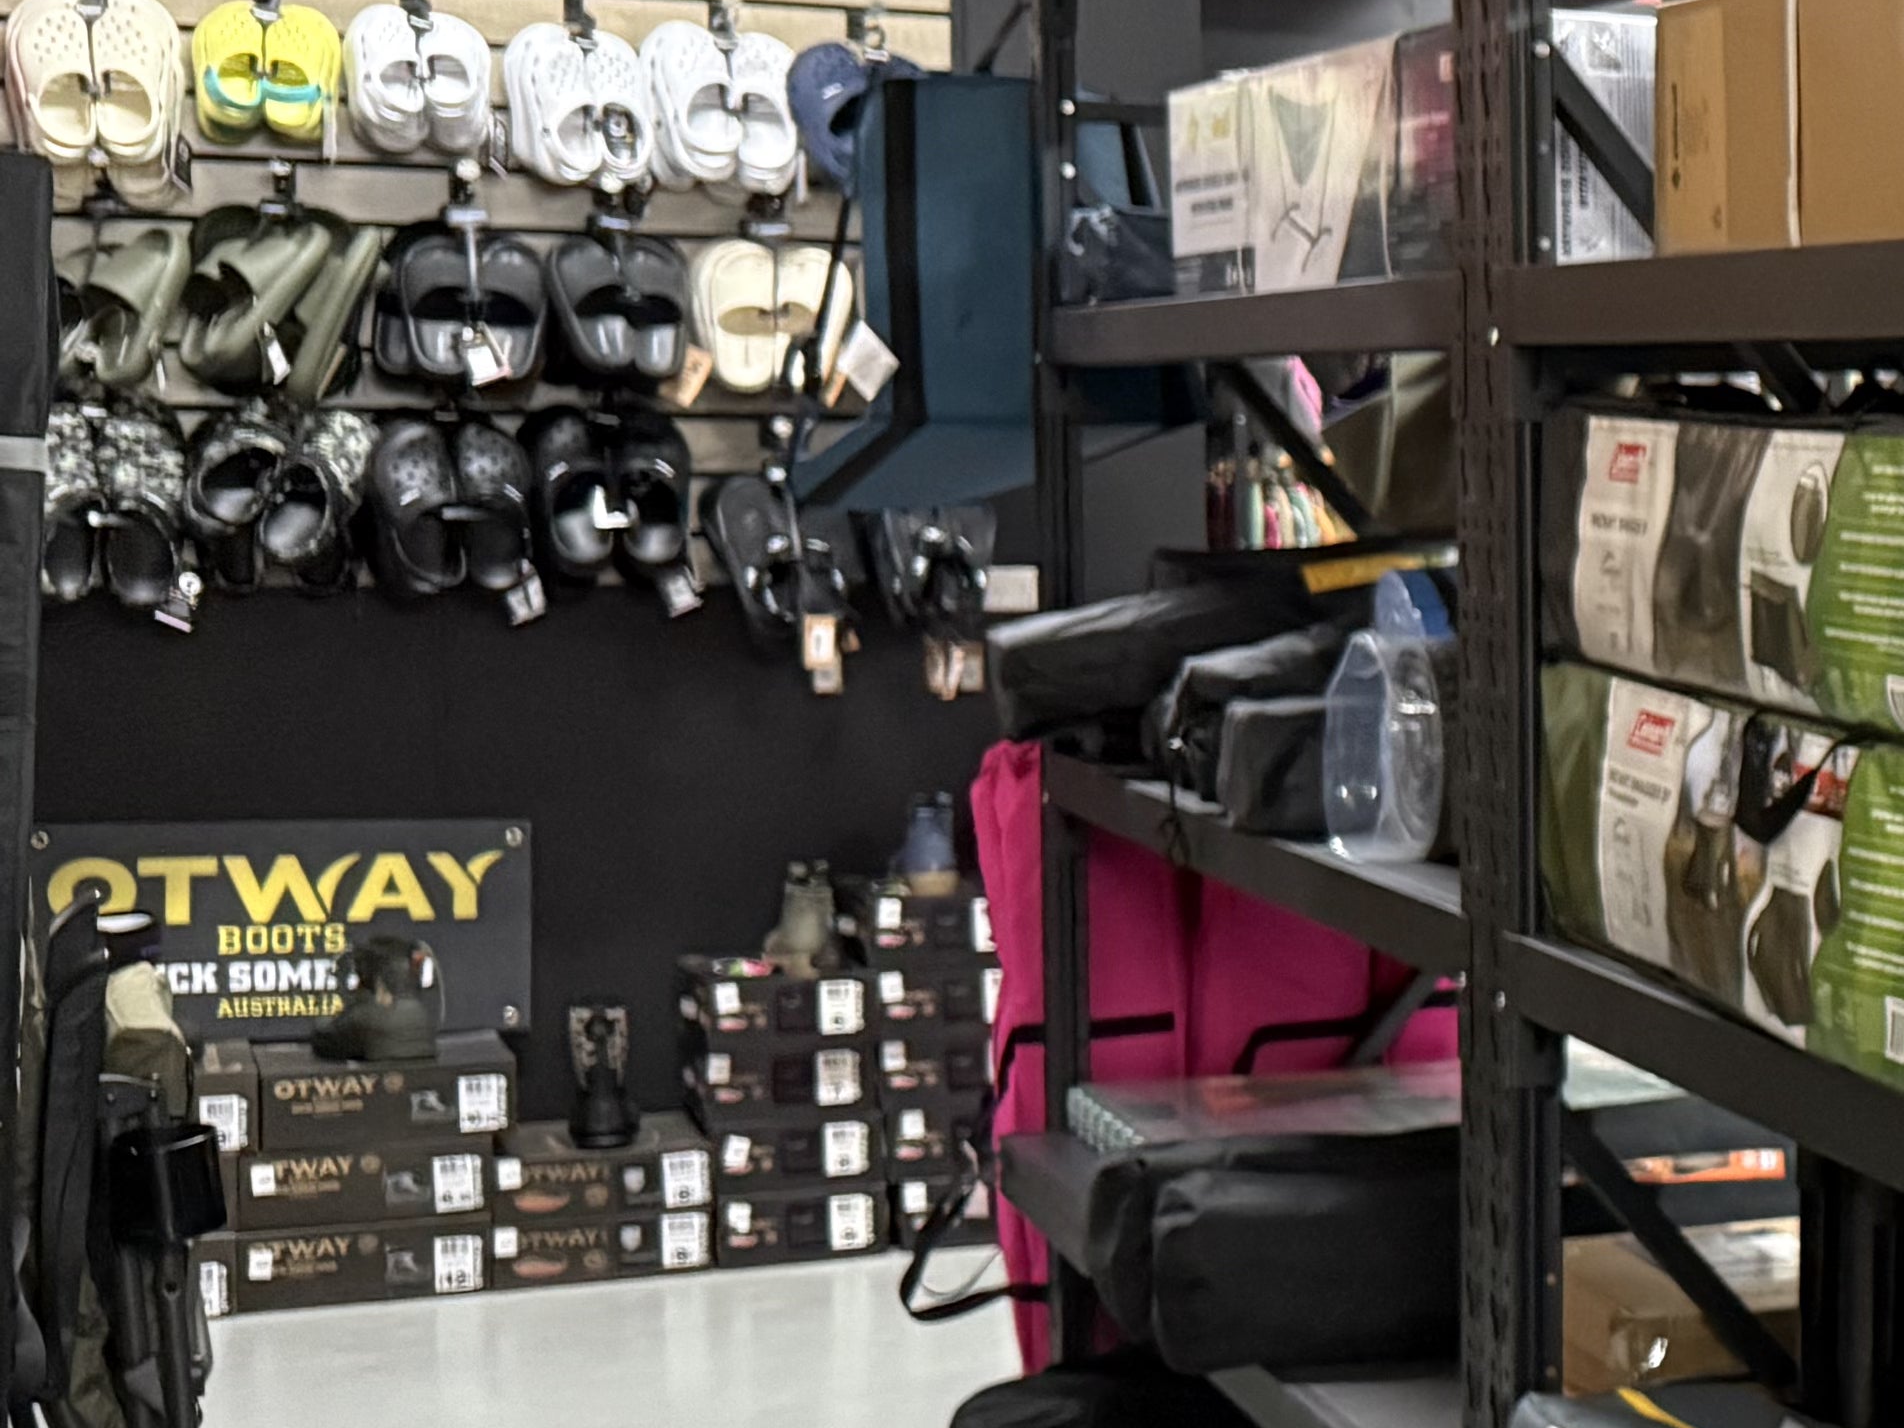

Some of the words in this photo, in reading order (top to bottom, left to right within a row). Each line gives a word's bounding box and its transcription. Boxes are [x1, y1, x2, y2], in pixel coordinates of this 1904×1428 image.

[47, 850, 504, 925] OTWAY
[217, 924, 347, 955] BOOTS
[274, 1075, 379, 1101] OTWAY
